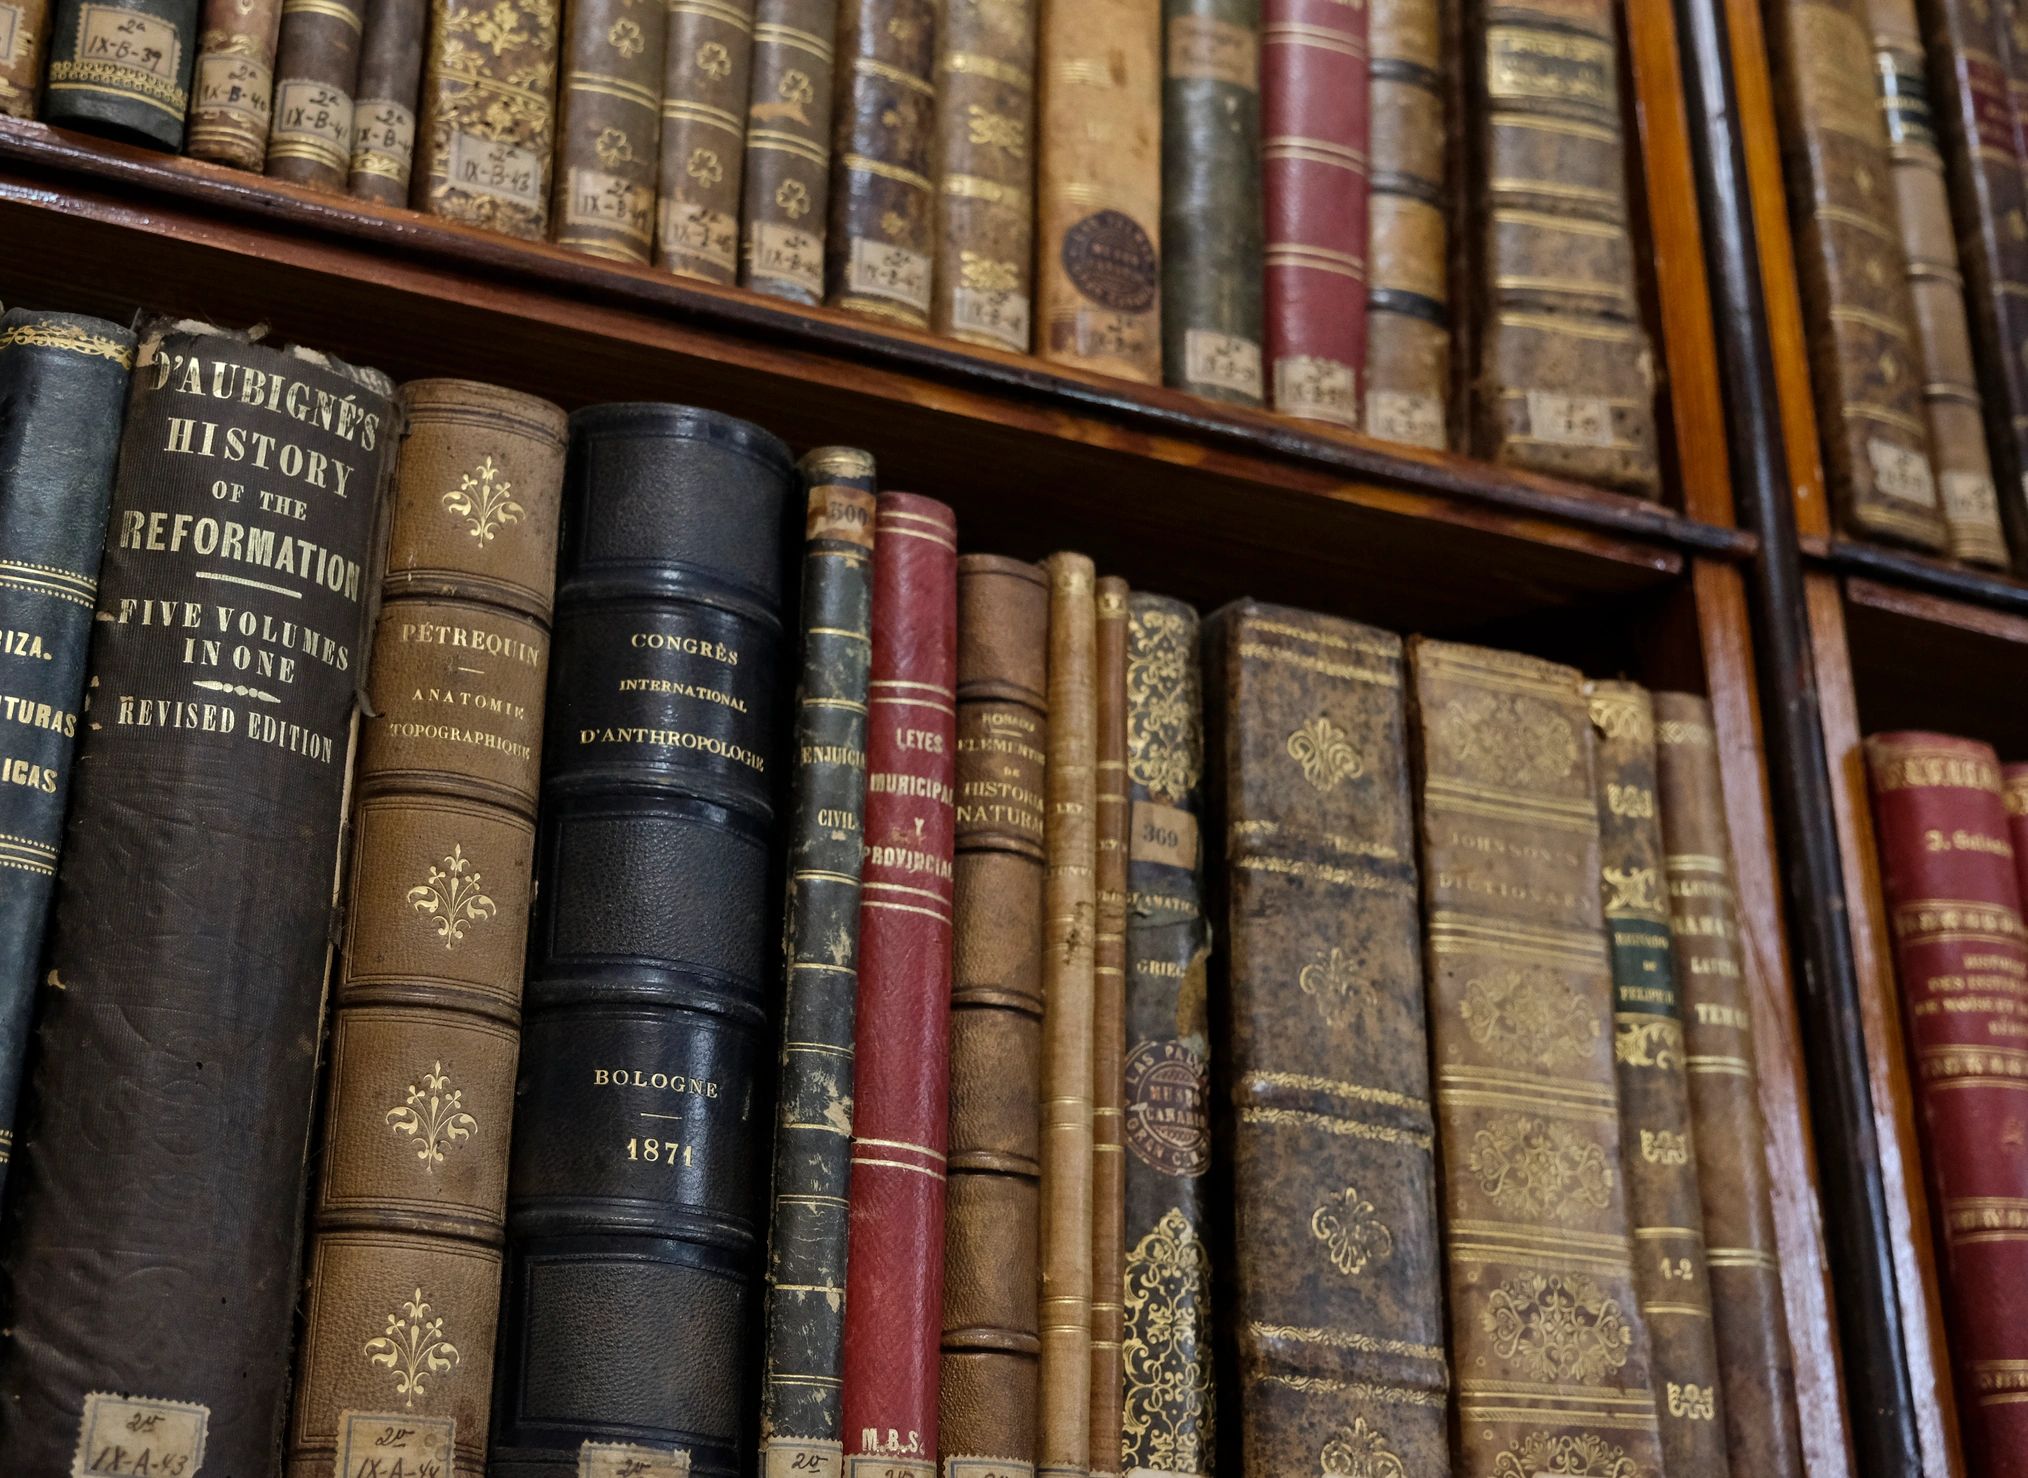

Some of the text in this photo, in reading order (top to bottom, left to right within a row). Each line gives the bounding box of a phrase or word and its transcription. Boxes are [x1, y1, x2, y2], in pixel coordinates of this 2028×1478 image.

[164, 416, 355, 498] HISTORY
[212, 480, 308, 521] OF THE
[120, 510, 361, 602] REFORMATION
[0, 628, 53, 662] IZA.
[117, 598, 350, 673] FIVE VOLUMES
[401, 622, 542, 667] PÉTREQUIN
[631, 632, 740, 667] CONGRÈS
[183, 637, 296, 684] IN ONE
[411, 687, 526, 721] ANATOMIE
[618, 678, 748, 714] INTERNATIONAL
[0, 694, 77, 738] TURAS
[118, 696, 334, 764] REVISED EDITION
[390, 722, 531, 761] TOPOGRAPHIQUE
[579, 727, 765, 773] D'ANTHROPOLOGIE
[896, 727, 944, 754] LEYES
[818, 808, 856, 830] CIVIL
[914, 816, 925, 838] Y
[1143, 822, 1178, 848] 369
[593, 1068, 719, 1099] BOLOGNE
[627, 1138, 693, 1168] 1871
